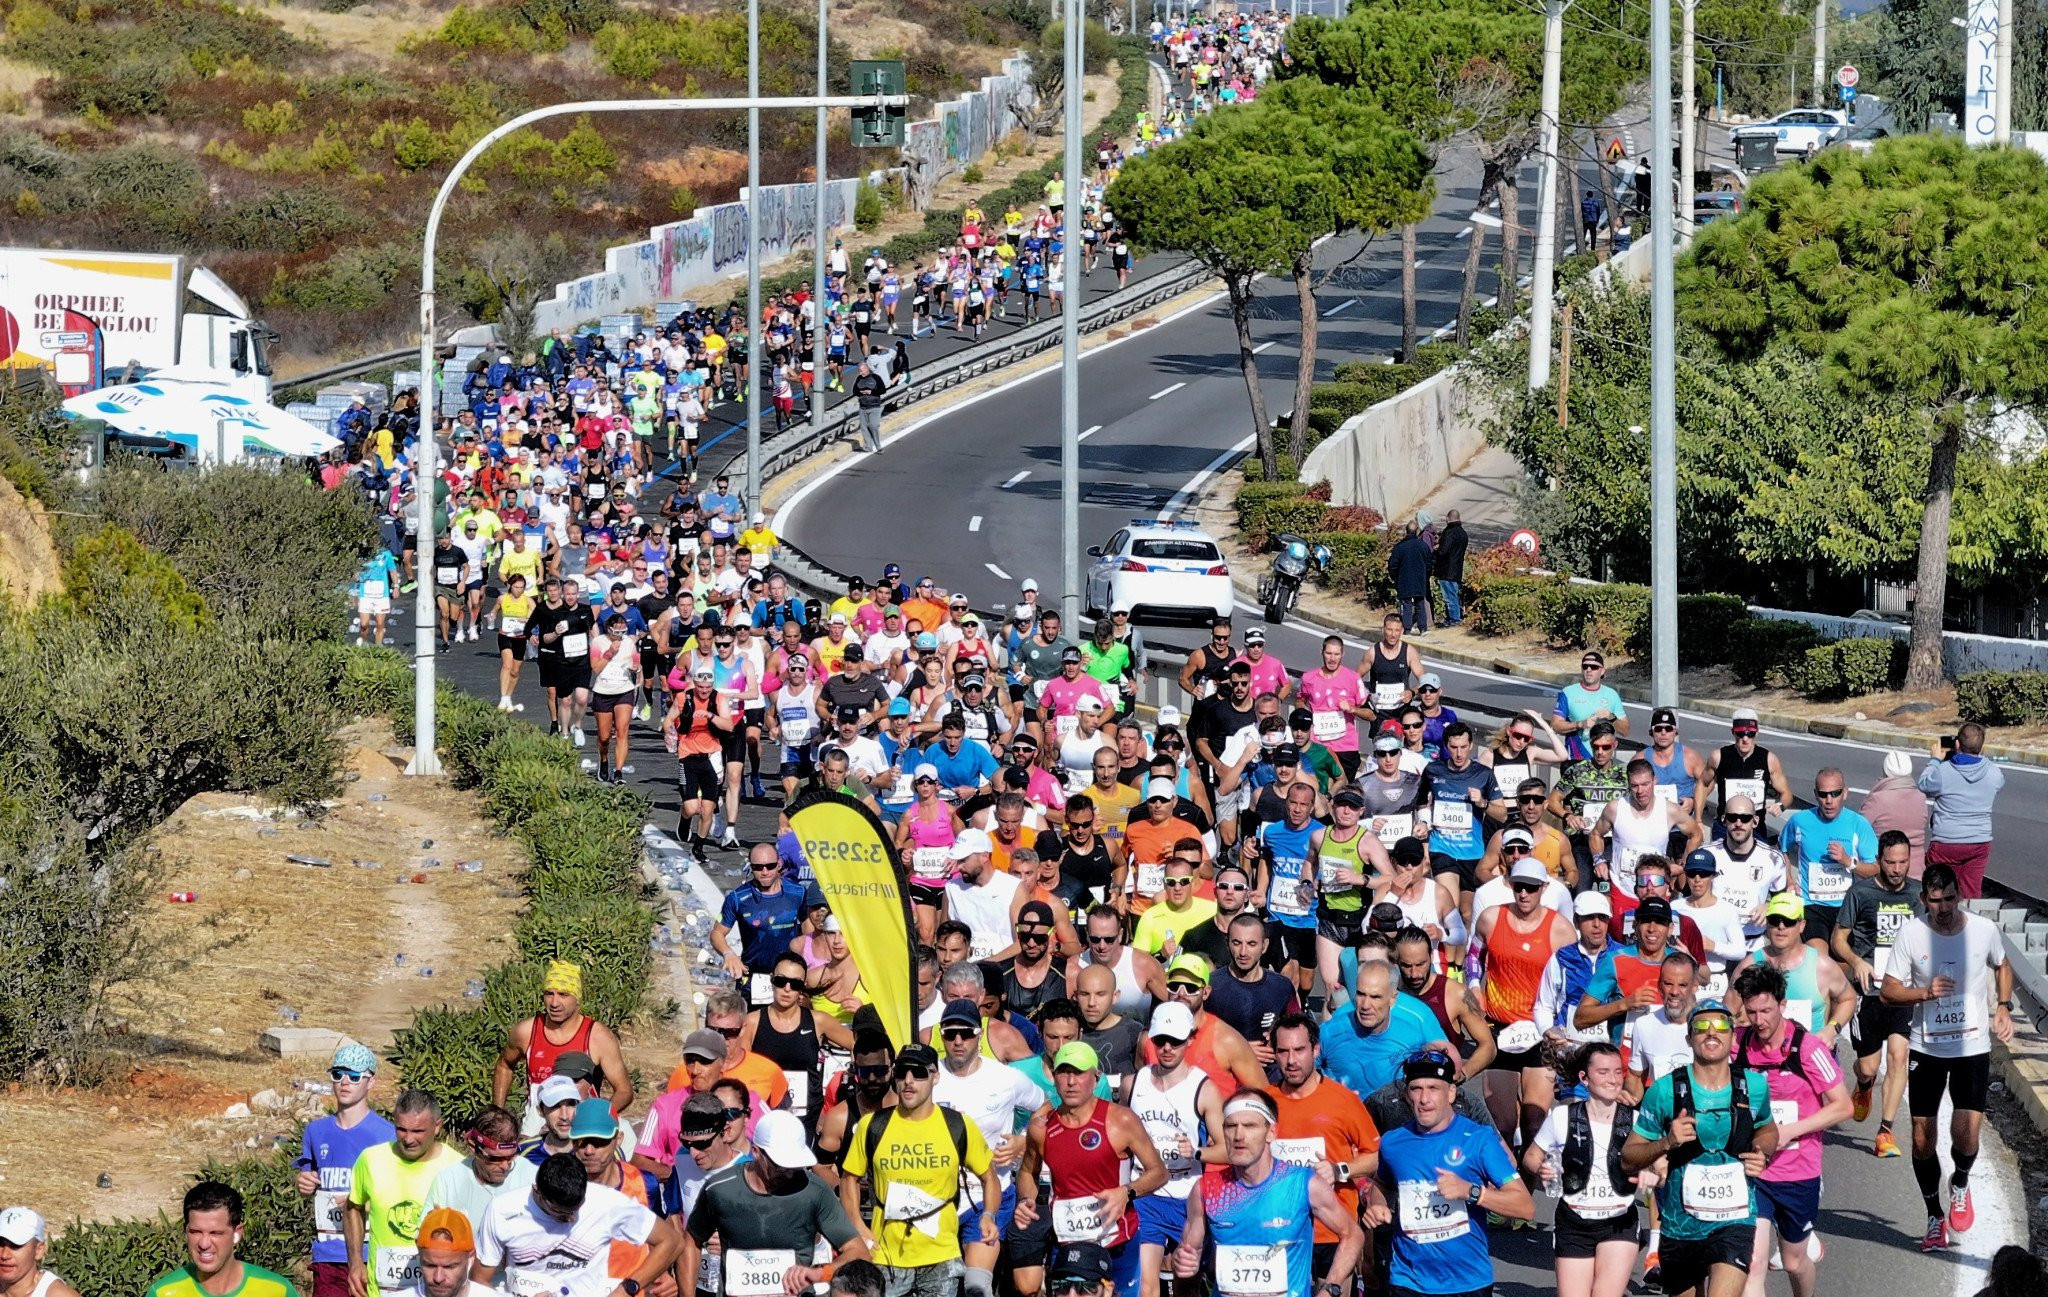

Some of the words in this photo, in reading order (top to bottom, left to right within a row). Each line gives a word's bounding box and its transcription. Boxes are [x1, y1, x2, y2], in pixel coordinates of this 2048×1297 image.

[1839, 72, 1857, 81] STOP
[1975, 16, 1999, 135] MYRTO
[34, 293, 125, 313] ORPHEE
[34, 313, 158, 334] BEOGLOU
[1442, 813, 1464, 823] 3400
[1382, 826, 1405, 836] 4107
[1935, 1012, 1965, 1024] 4482
[1509, 1032, 1537, 1045] 4221
[891, 1143, 934, 1156] PACE
[880, 1155, 950, 1171] RUNNER
[1582, 1184, 1615, 1198] 4182
[1697, 1184, 1734, 1199] 4593
[1414, 1204, 1451, 1220] 3752
[387, 1266, 422, 1280] 4506
[741, 1271, 781, 1285] 3880
[1232, 1268, 1272, 1283] 3779
